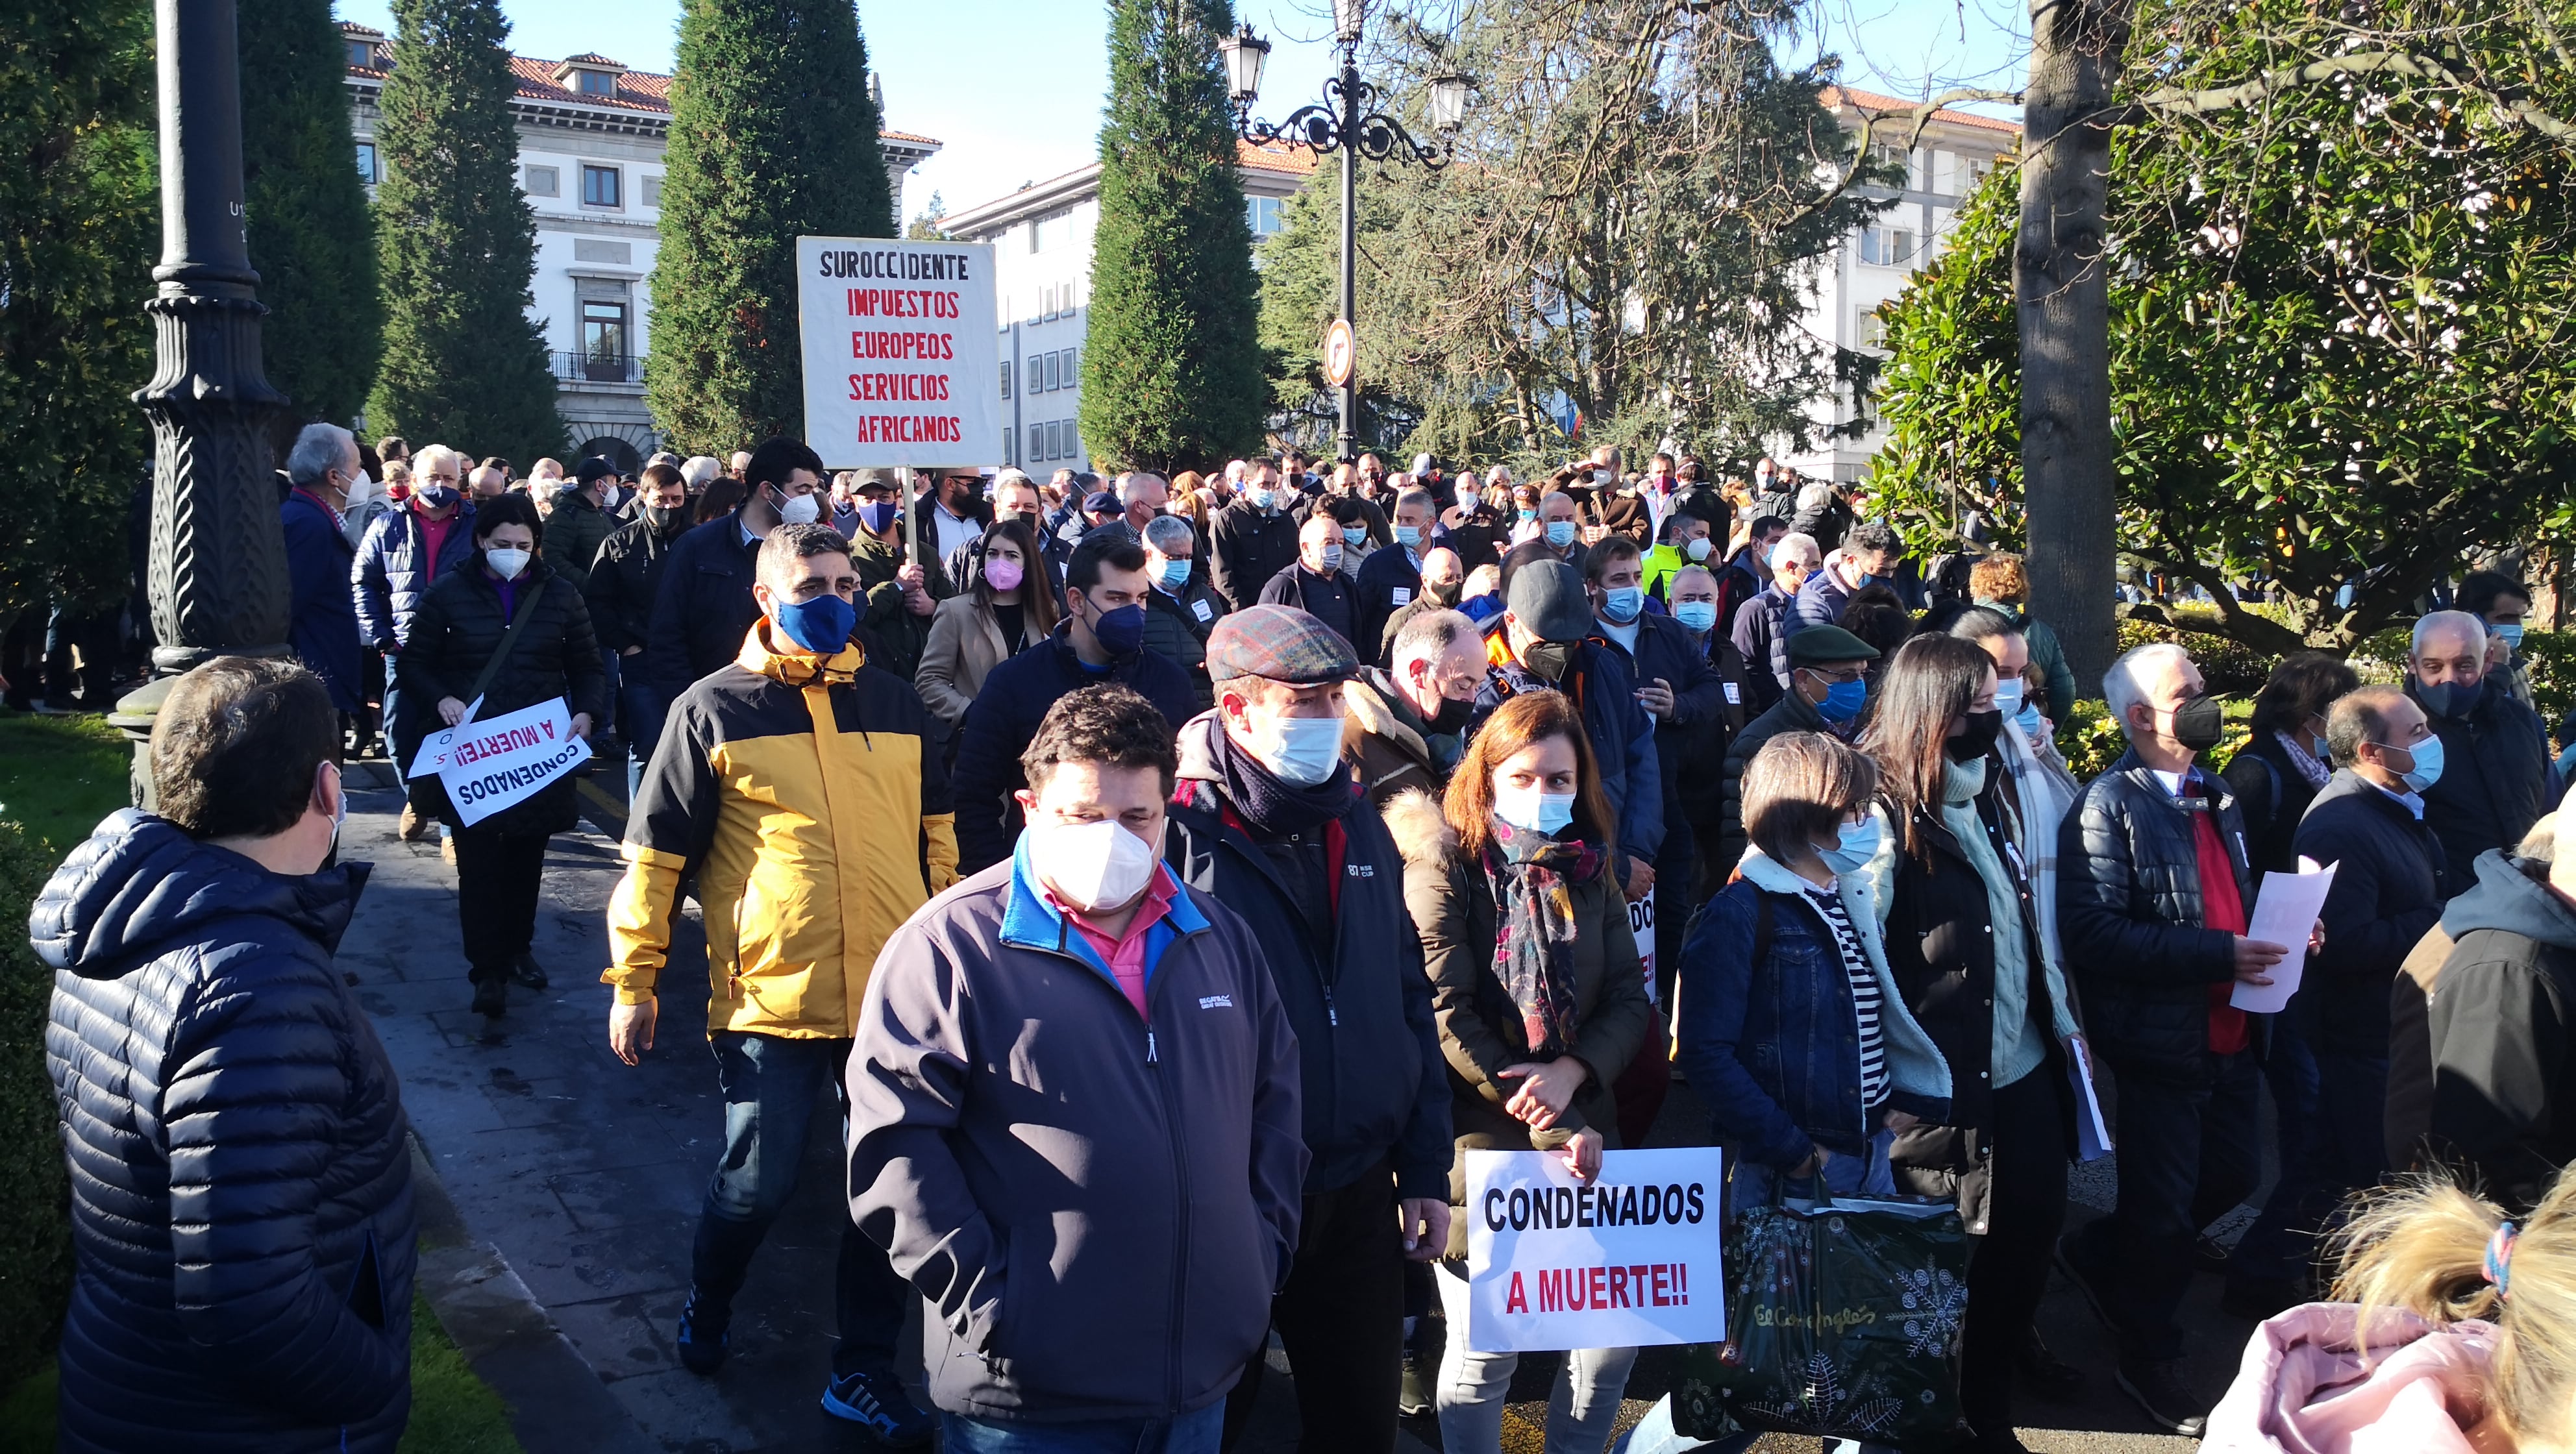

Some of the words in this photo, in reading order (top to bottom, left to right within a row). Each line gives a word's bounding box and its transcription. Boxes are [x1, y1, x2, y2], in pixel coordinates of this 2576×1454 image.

[230, 201, 245, 217] U1
[819, 251, 969, 280] SUROCCIDENTE
[847, 288, 960, 319] IMPUESTOS
[852, 331, 954, 360] EUROPEOS
[848, 373, 949, 401] SERVICIOS
[858, 415, 961, 443] AFRICANOS
[539, 719, 555, 740] A
[454, 724, 541, 767] MUERTE!!
[458, 744, 579, 805] CONDENADOS
[1485, 1182, 1704, 1232] CONDENADOS
[1505, 1271, 1530, 1314] A
[1539, 1263, 1689, 1312] MUERTE!!
